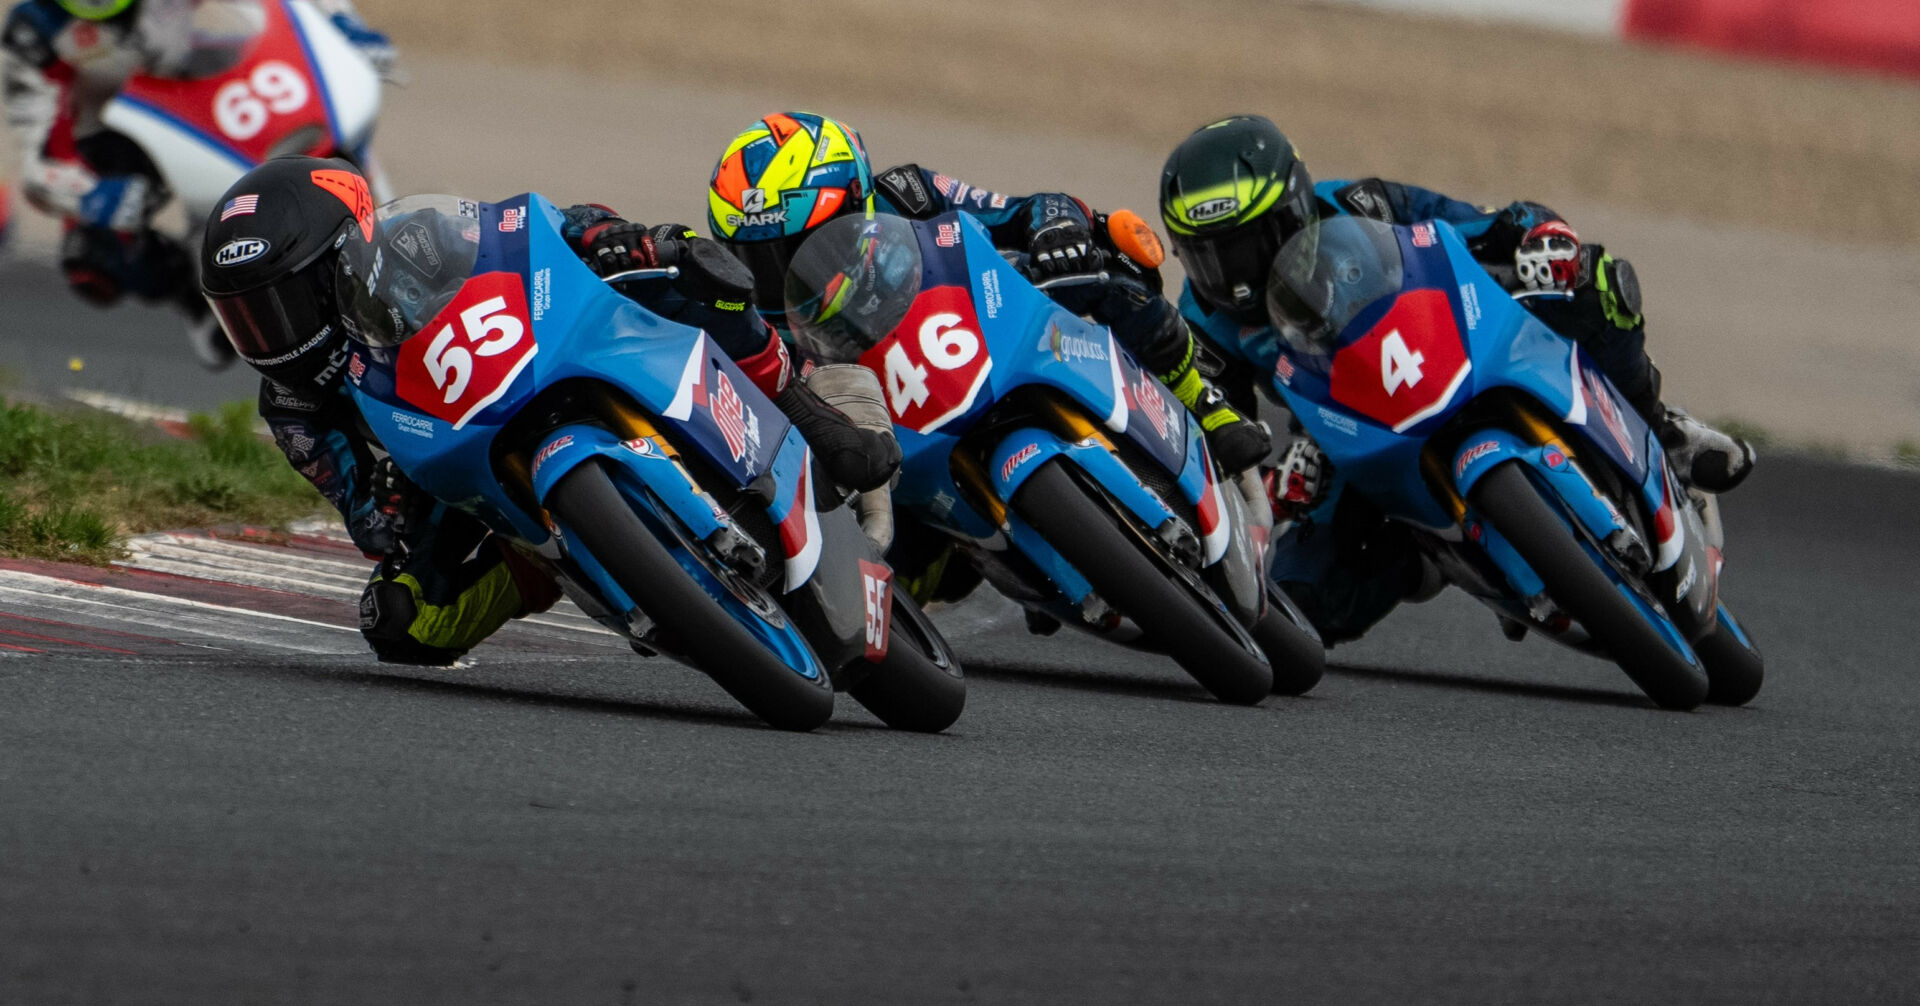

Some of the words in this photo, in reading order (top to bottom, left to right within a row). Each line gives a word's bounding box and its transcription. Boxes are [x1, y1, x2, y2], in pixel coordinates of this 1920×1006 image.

[213, 61, 308, 140] 69
[726, 210, 787, 227] SHARK
[1192, 198, 1234, 219] HJC
[218, 241, 261, 264] HJC
[534, 269, 545, 321] FERROCARRIL
[982, 269, 998, 319] FERROCARRIL
[255, 350, 300, 366] MOTORCYCLE
[300, 324, 332, 353] ACADEMY
[422, 296, 524, 403] 55
[884, 313, 979, 418] 46
[1381, 329, 1425, 397] 4
[392, 411, 434, 432] FERROCARRIL
[864, 574, 887, 650] 55
